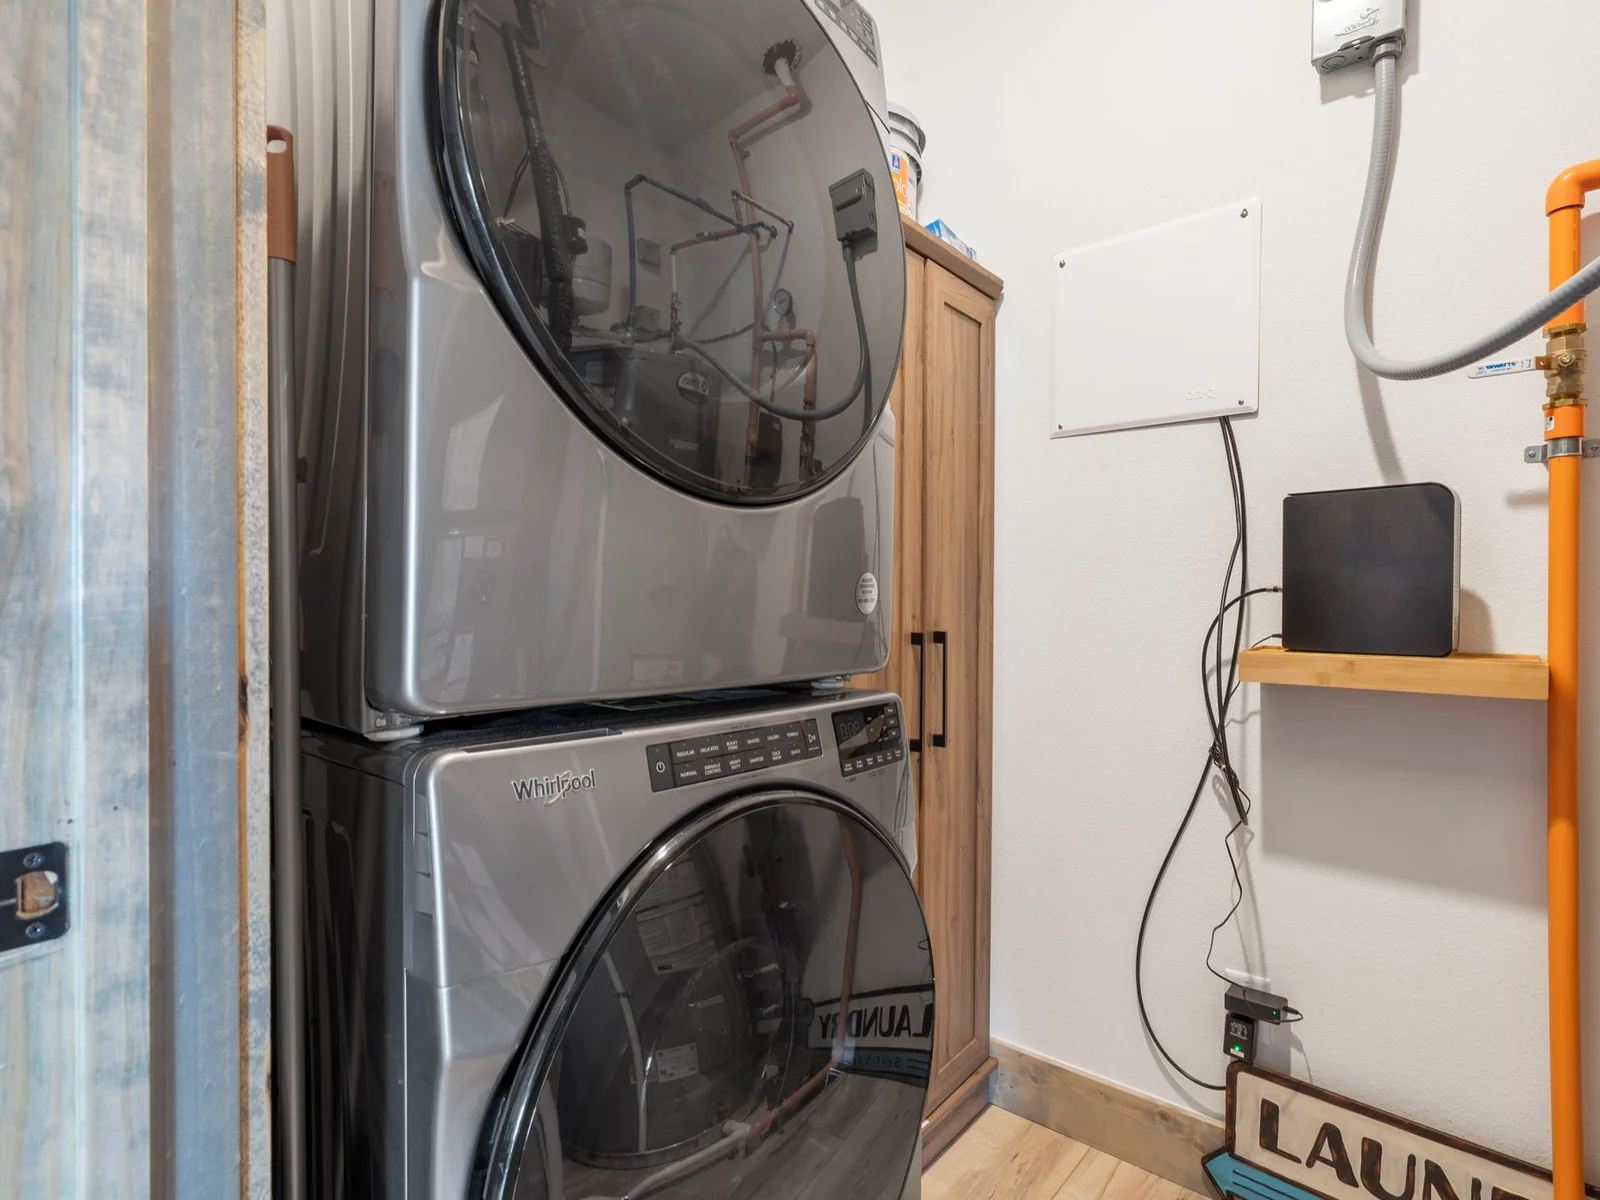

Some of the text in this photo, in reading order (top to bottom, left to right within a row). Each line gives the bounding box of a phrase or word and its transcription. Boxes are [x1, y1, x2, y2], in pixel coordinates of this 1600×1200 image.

[511, 768, 596, 802] Whirlpool
[680, 770, 698, 778] NORMAL
[1260, 1097, 1531, 1200] LAUN
